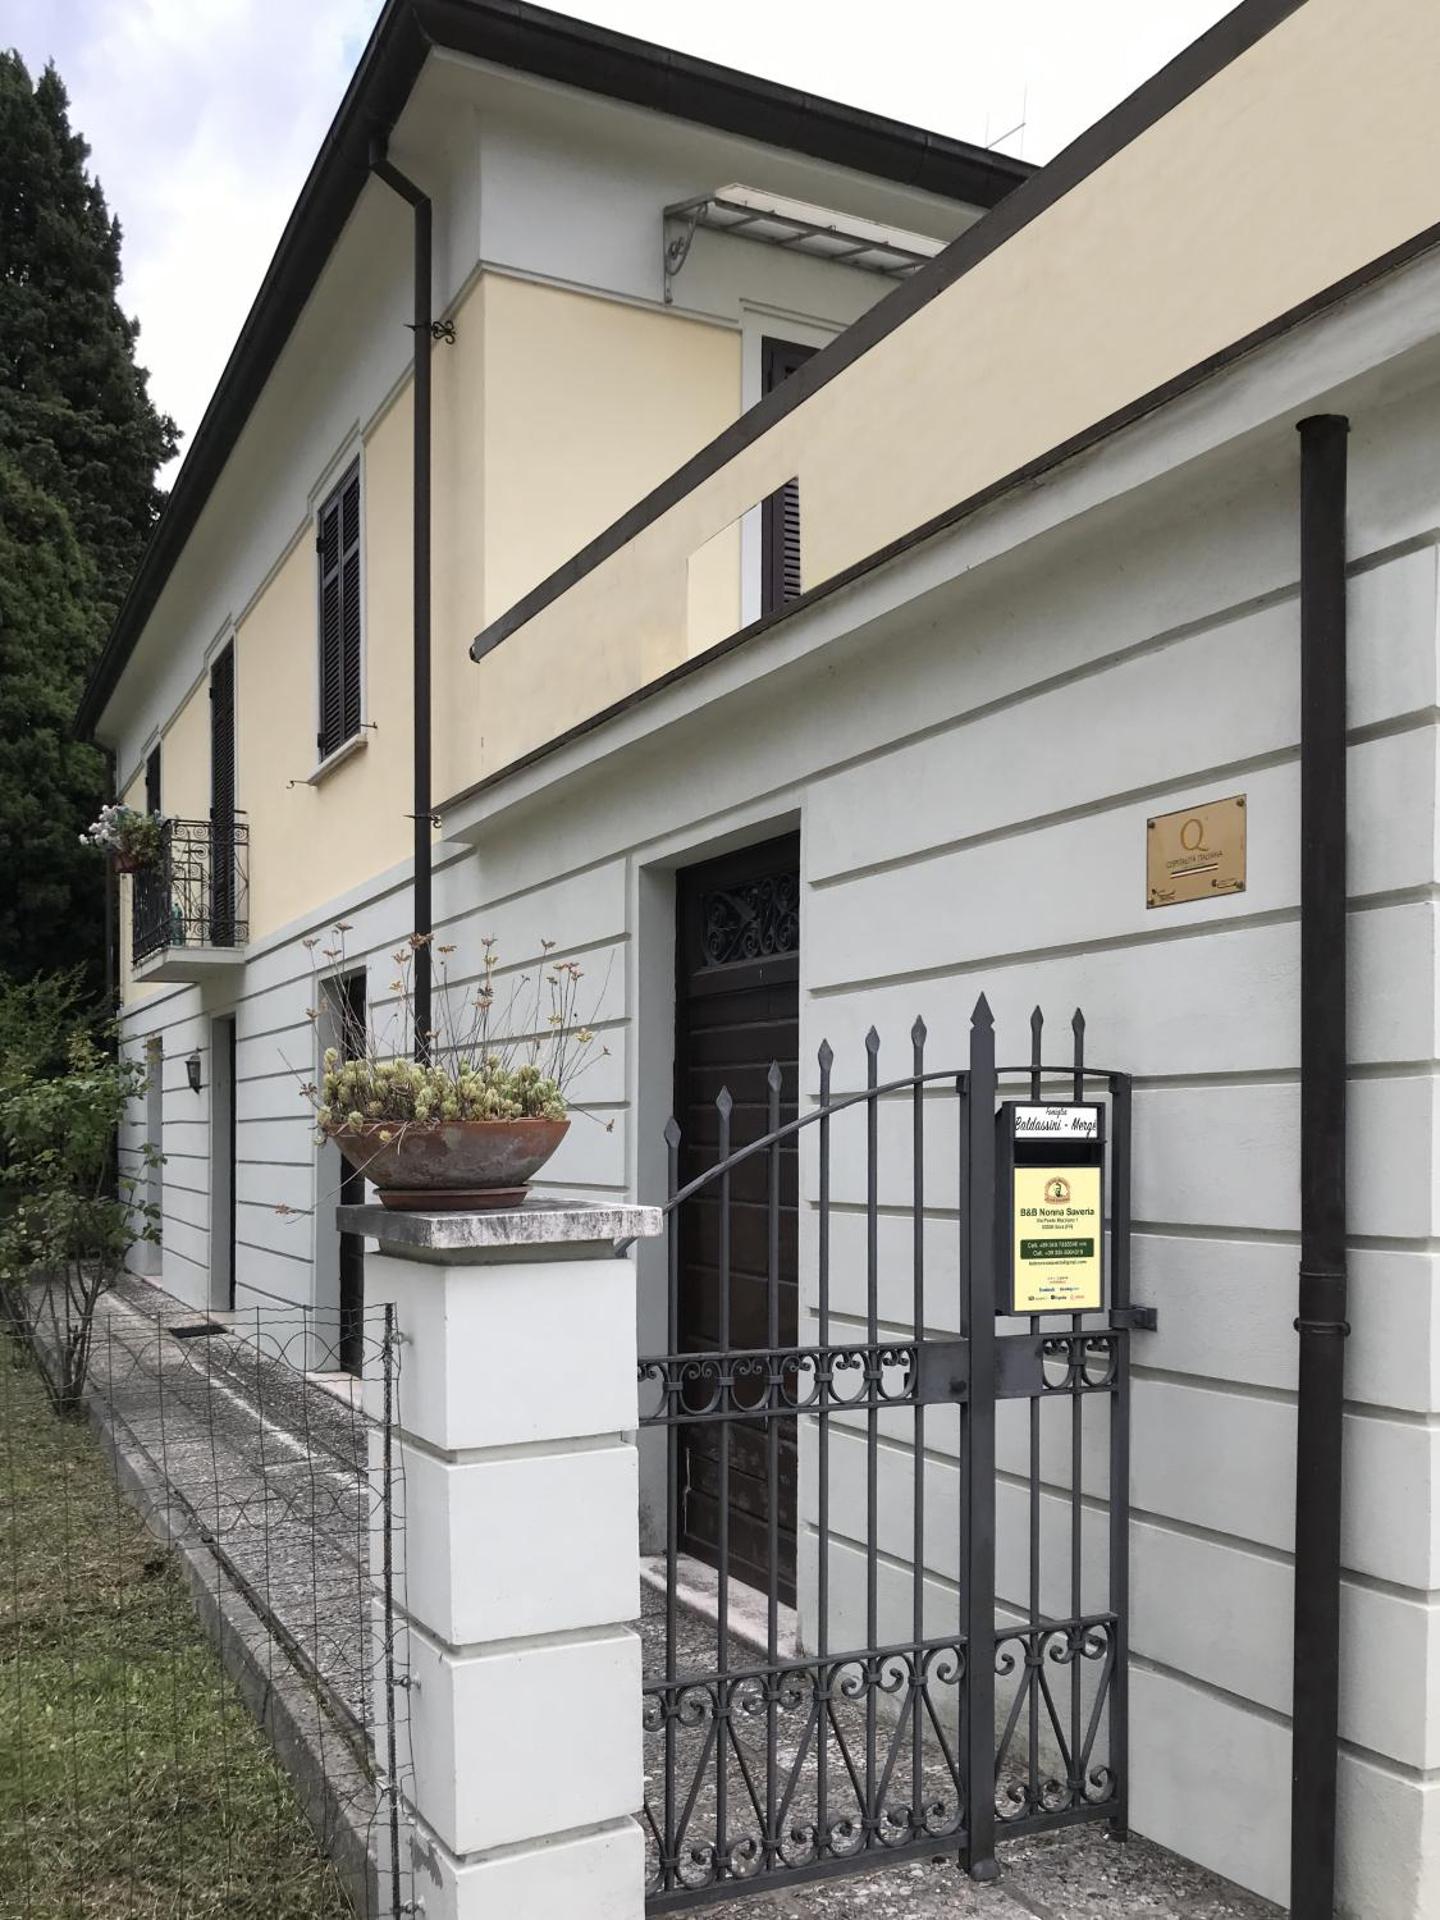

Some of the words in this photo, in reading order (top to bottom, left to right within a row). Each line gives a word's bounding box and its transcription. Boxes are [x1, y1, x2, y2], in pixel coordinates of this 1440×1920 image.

[1015, 1116, 1062, 1131] Baldassini
[1020, 1208, 1037, 1216] B&B
[1039, 1208, 1064, 1216] Nonna
[1066, 1207, 1095, 1216] Saveria
